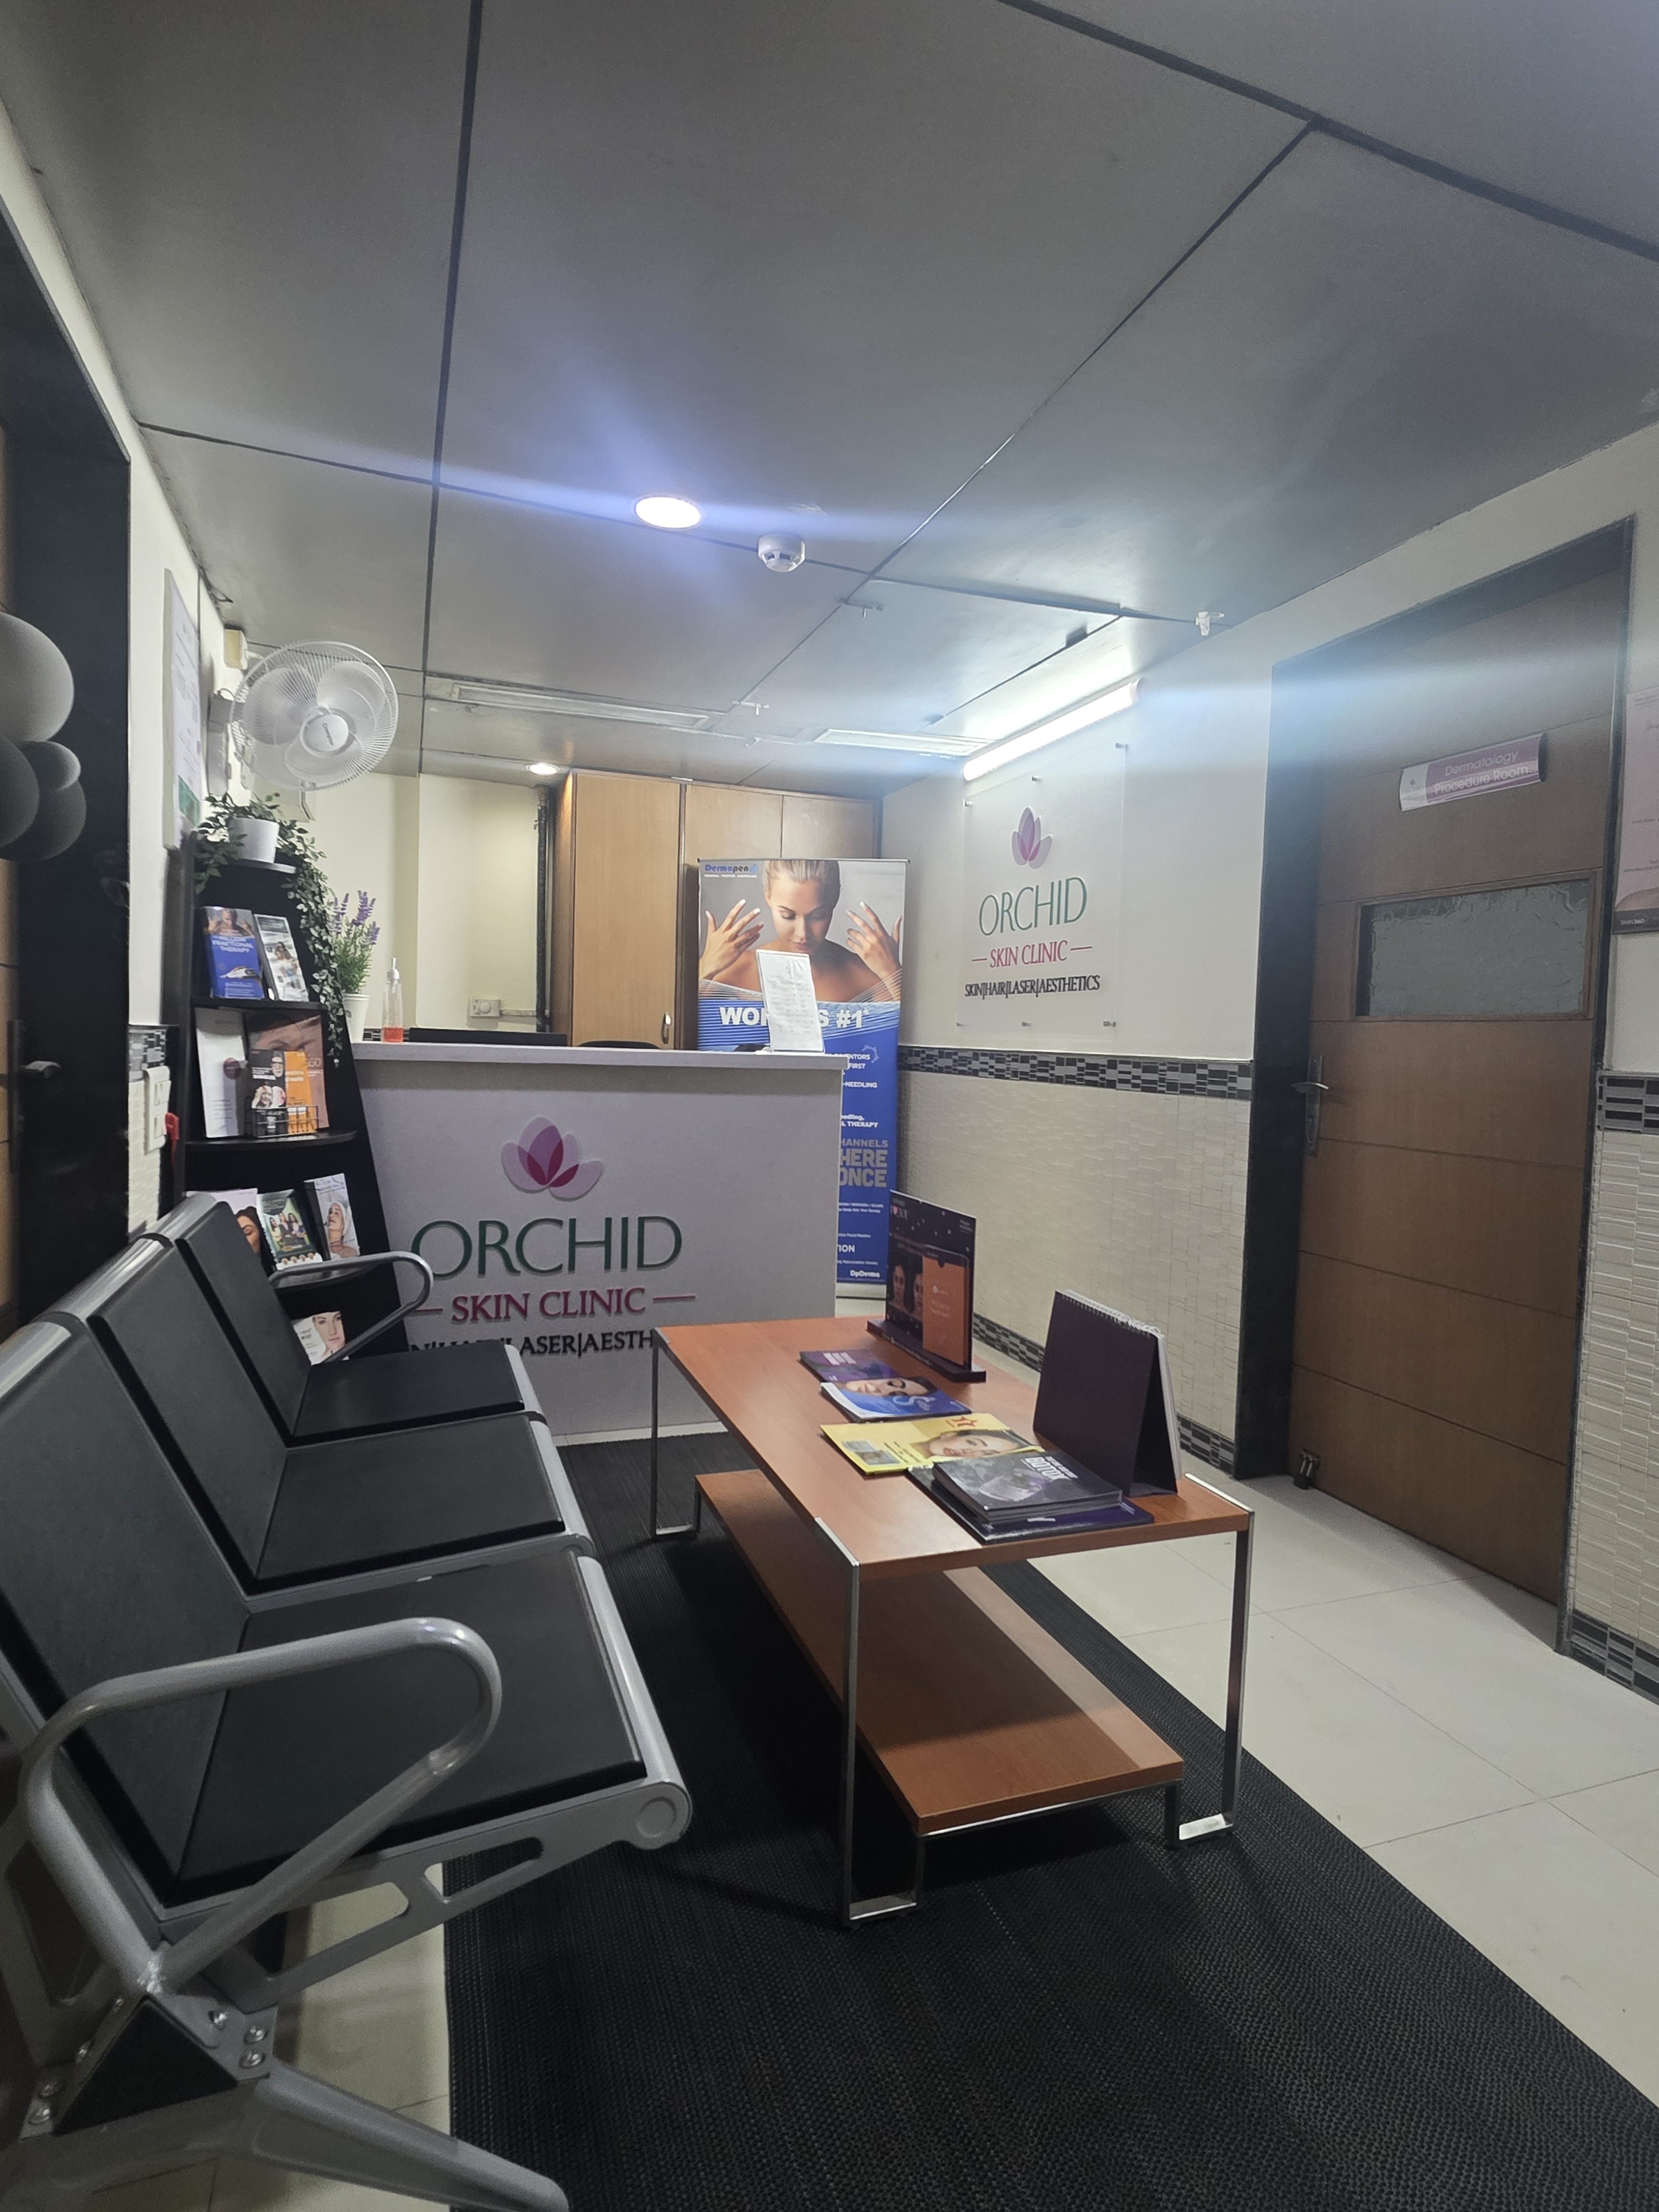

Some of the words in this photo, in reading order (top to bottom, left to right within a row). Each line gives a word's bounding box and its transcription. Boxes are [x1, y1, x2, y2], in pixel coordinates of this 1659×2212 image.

[1444, 750, 1519, 777] Dermatology
[1434, 773, 1491, 795] Procedure
[1494, 765, 1530, 781] Room
[705, 864, 749, 873] Dermapen
[978, 876, 1088, 936] ORCHID
[989, 946, 1019, 968] SKIN
[1021, 940, 1068, 965] CLINIC
[839, 1167, 888, 1188] ONCE
[411, 1215, 682, 1279] ORCHID
[451, 1292, 531, 1323] SKIN
[539, 1287, 646, 1319] CLINIC
[1024, 1456, 1071, 1481] BOTOX
